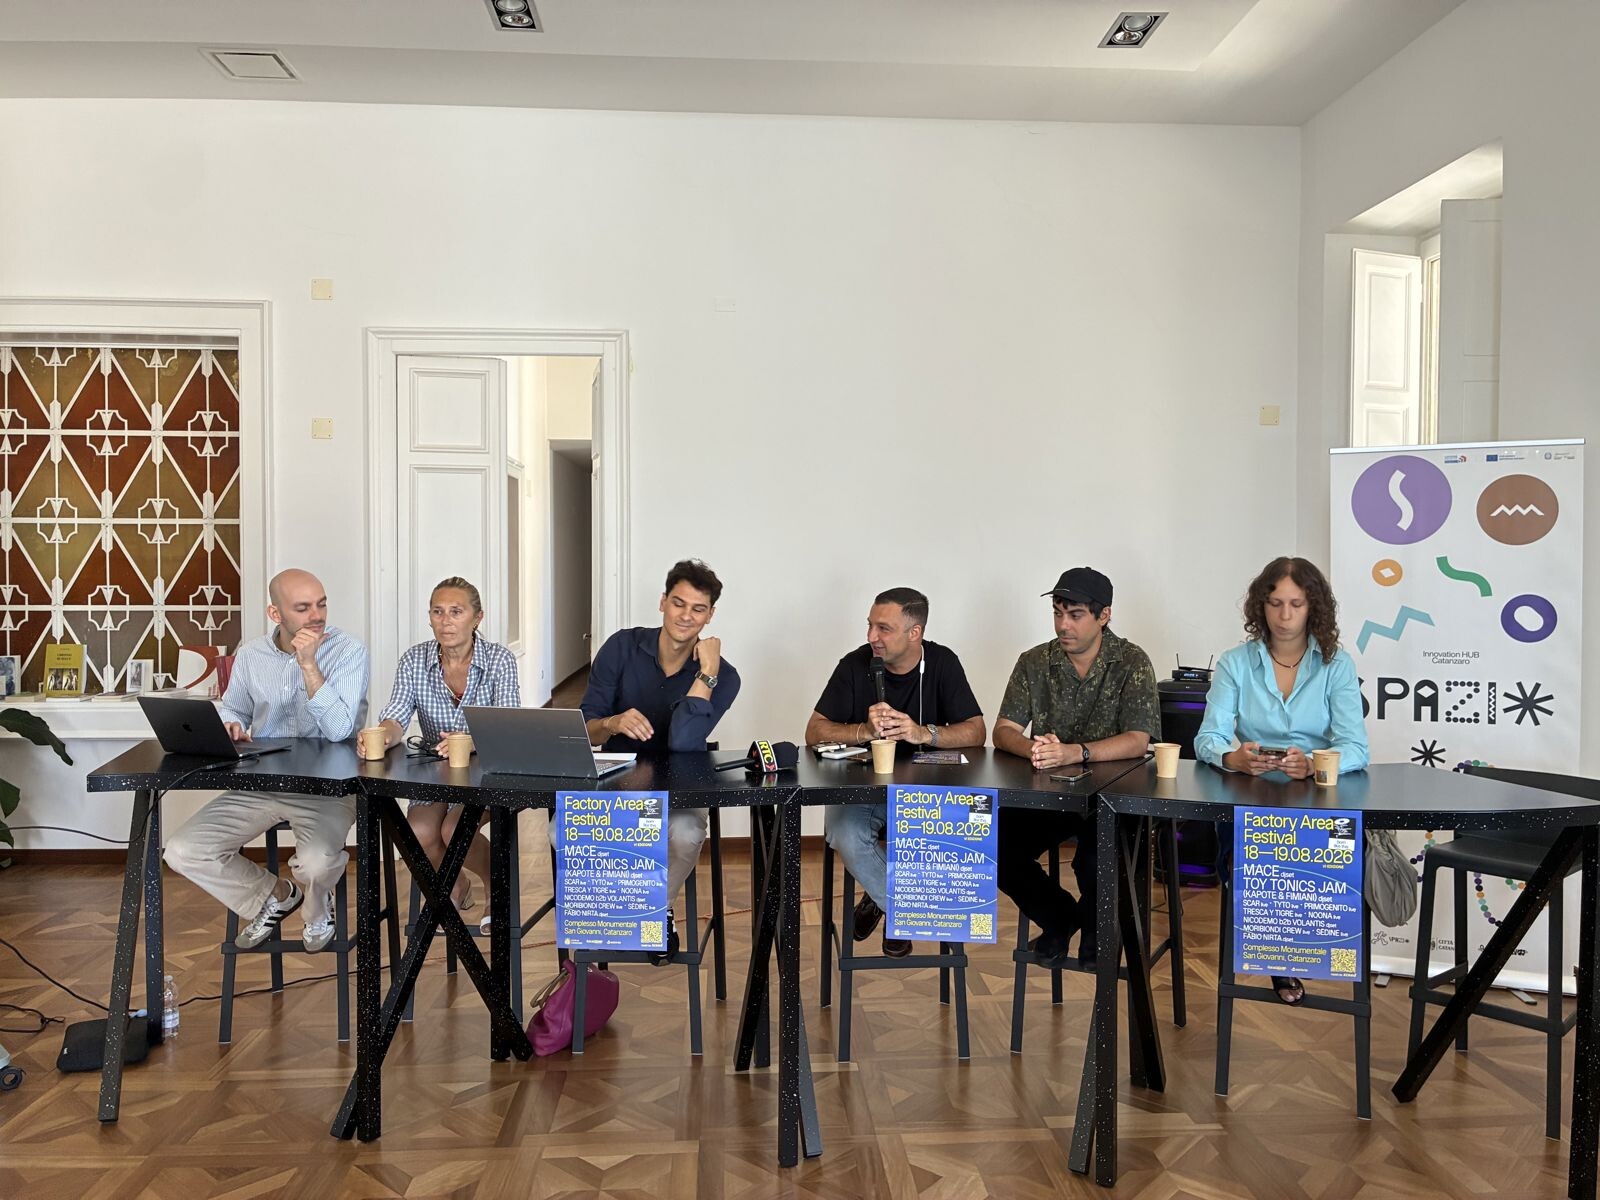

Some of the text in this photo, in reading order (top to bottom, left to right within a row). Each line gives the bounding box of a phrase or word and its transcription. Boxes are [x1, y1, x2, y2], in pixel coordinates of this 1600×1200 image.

[896, 790, 942, 806] Factory
[945, 792, 974, 805] Area
[565, 796, 612, 812] Factory
[614, 797, 644, 811] Area
[896, 805, 941, 819] Festival
[565, 812, 610, 825] Festival
[1245, 812, 1334, 831] Factory Area
[1245, 829, 1296, 845] Festival
[896, 838, 926, 849] MACE
[565, 845, 596, 856] MACE
[896, 851, 984, 863] TOY TONICS JAM
[565, 858, 654, 870] TOY TONICS JAM
[565, 870, 594, 878] (KAPOTE
[602, 871, 629, 879] FIMIANI)
[1244, 864, 1279, 877] MACE
[1243, 878, 1346, 894] TOY TONICS JAM
[1243, 891, 1276, 899] (KAPOTE
[1286, 893, 1317, 902] FIMIANI)
[1243, 908, 1268, 916] TRESCA
[1304, 903, 1347, 912] PRIMOGENITO
[895, 911, 967, 920] Complesso Monumentale
[565, 920, 637, 929] Complesso Monumentale
[1292, 919, 1325, 927] VOLANTIS
[577, 928, 602, 936] Giovanni,
[1243, 943, 1326, 955] Complesso Monumentale
[1257, 953, 1286, 962] Giovanni,
[1288, 954, 1321, 964] Catanzaro
